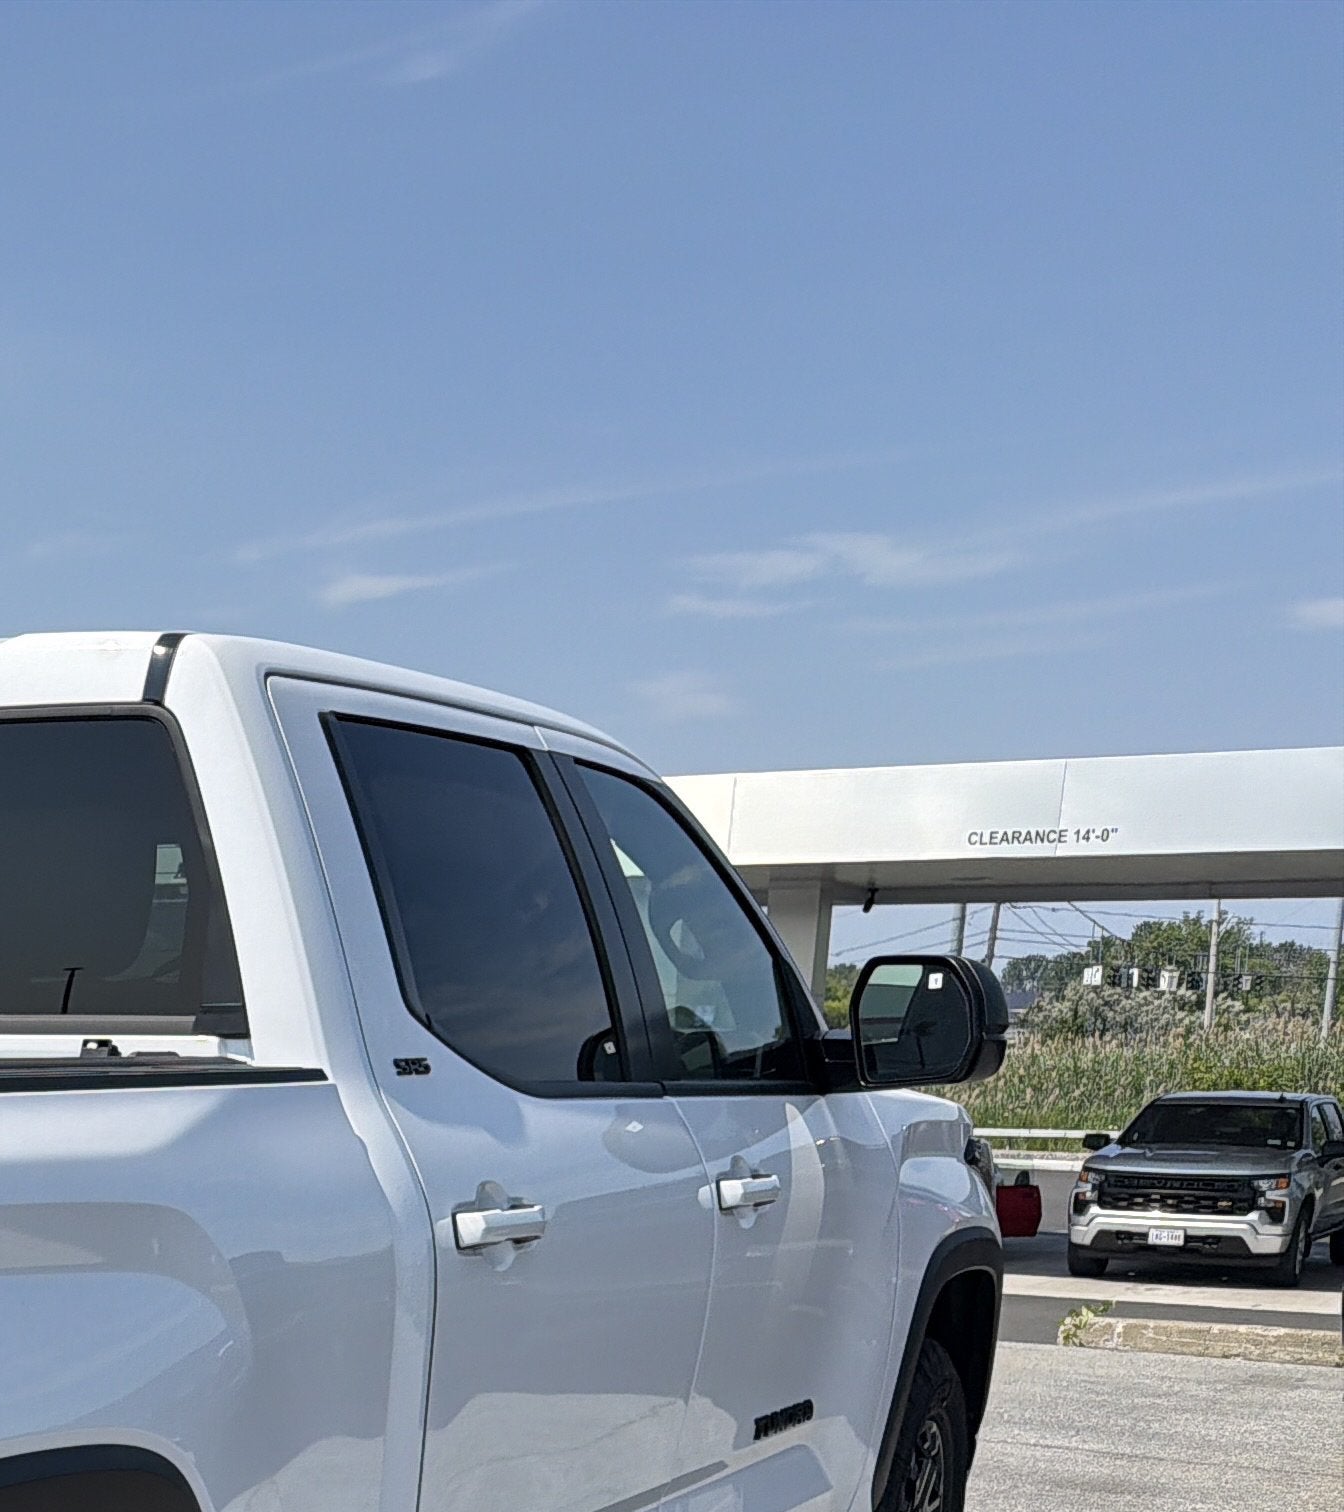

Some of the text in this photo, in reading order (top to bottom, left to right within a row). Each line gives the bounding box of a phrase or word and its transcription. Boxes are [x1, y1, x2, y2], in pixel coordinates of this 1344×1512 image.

[967, 827, 1119, 846] CLEARANCE 14'-0"
[393, 1057, 431, 1076] SR5
[753, 1398, 814, 1441] TUNDRA
